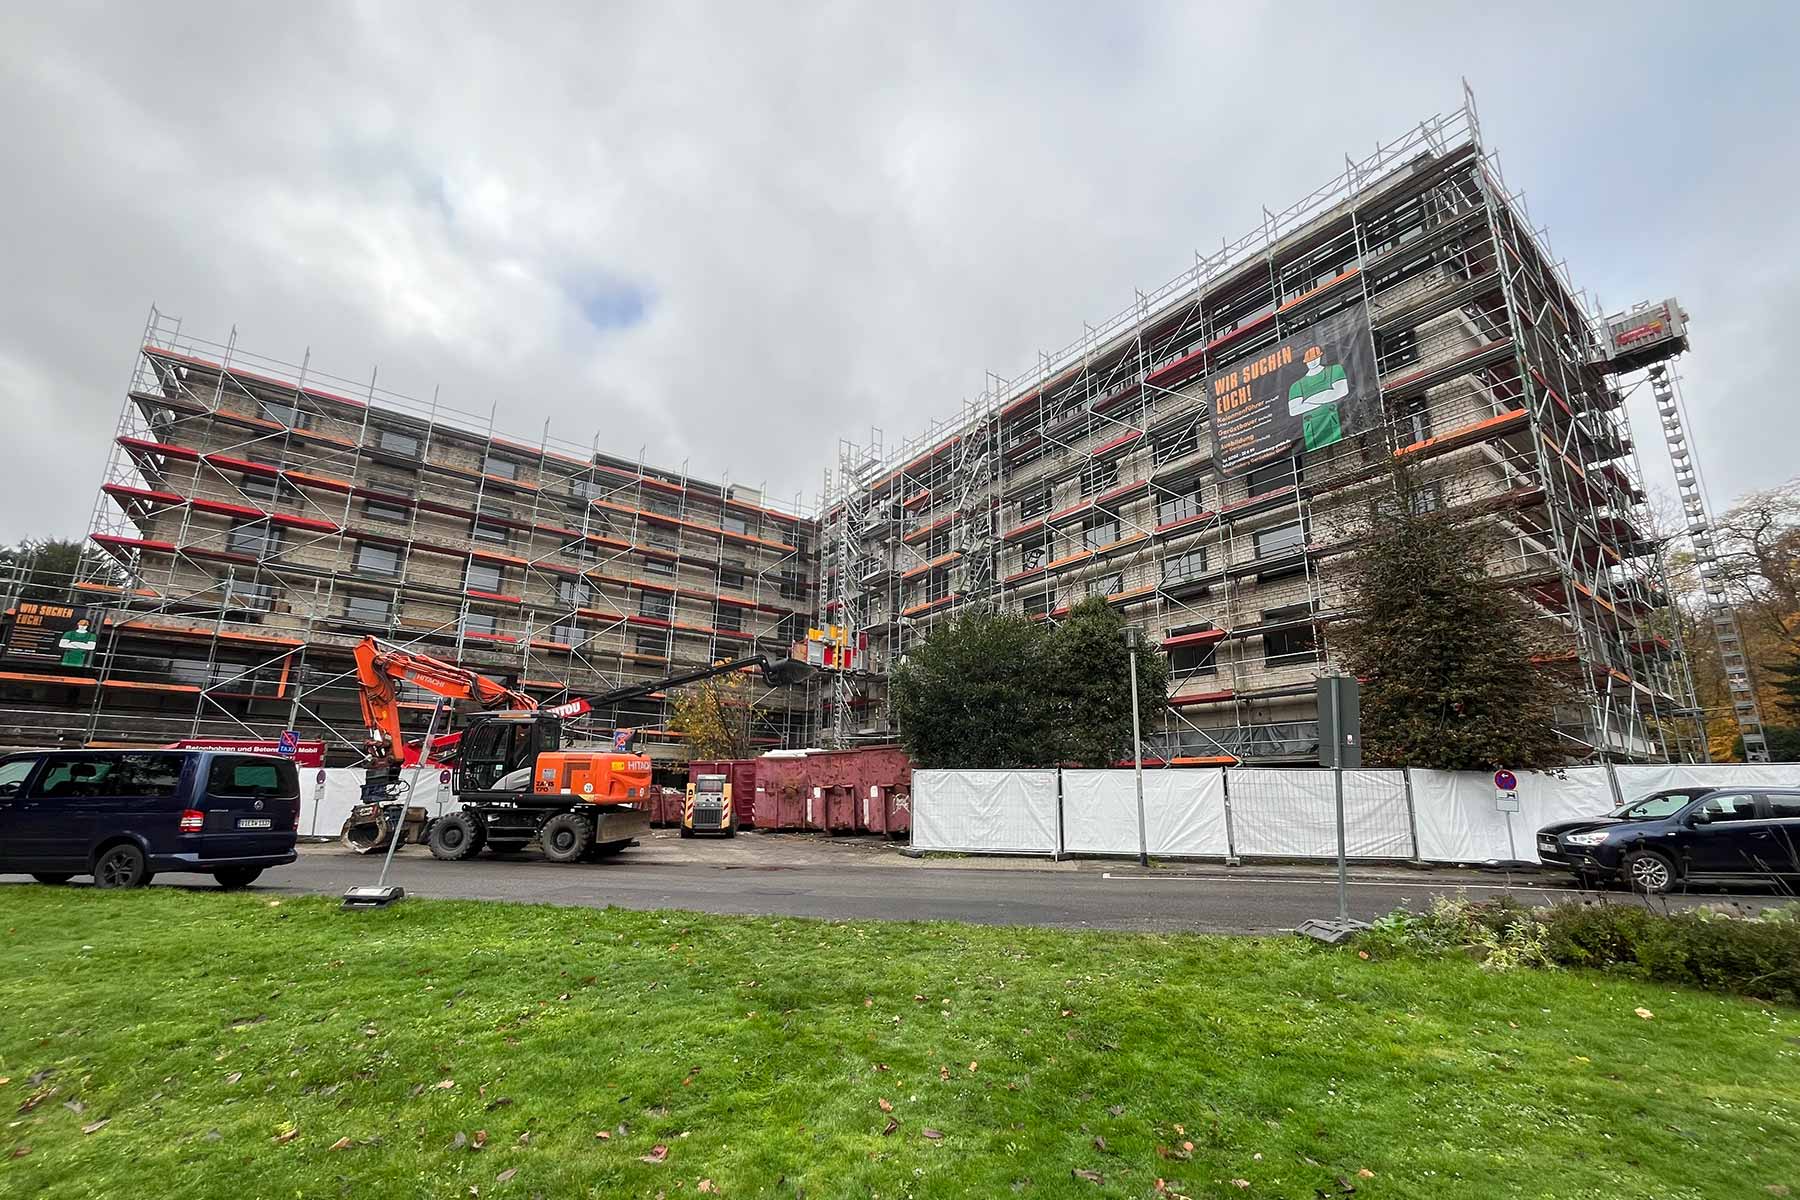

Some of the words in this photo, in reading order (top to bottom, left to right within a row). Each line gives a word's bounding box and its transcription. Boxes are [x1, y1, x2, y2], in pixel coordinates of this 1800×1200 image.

[1215, 371, 1238, 396] WIR
[1243, 346, 1292, 384] SUCHEN
[1216, 384, 1252, 415] EUCH!
[20, 603, 38, 614] WIR
[40, 605, 74, 618] SUCHEN
[16, 613, 44, 626] EUCH!
[416, 673, 446, 687] HITACHI
